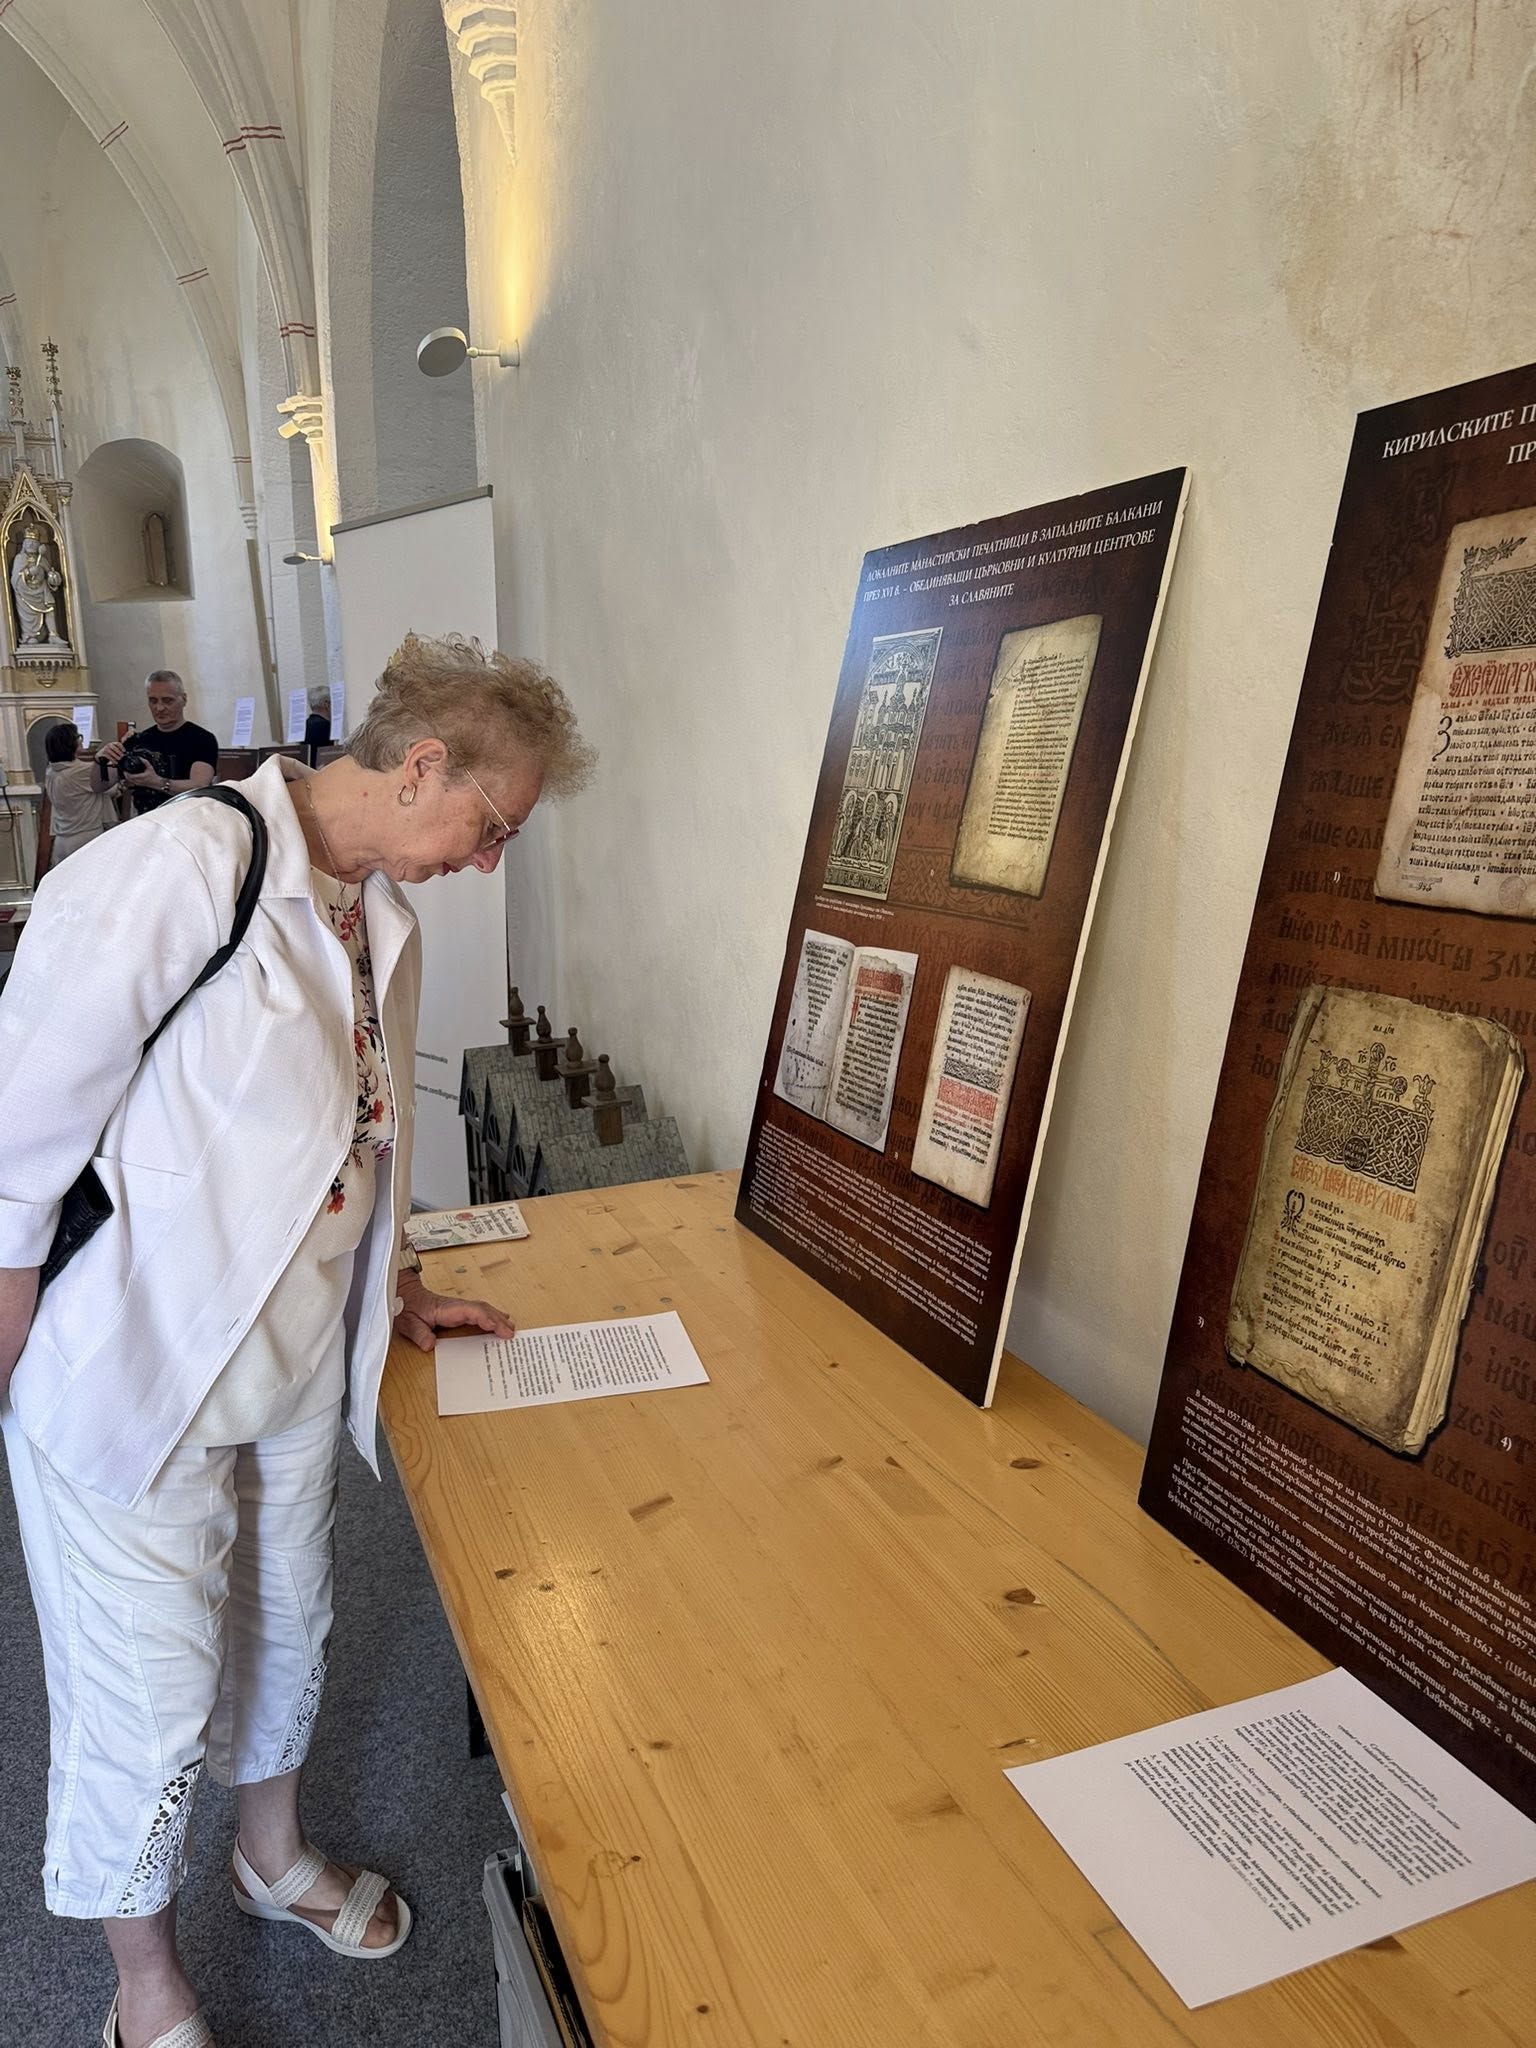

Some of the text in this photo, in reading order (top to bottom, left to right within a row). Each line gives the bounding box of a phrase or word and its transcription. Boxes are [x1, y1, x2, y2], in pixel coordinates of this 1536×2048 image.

[1381, 409, 1515, 459] КИРИЛСКИТЕ
[863, 589, 881, 602] ПРЕЗ
[909, 567, 972, 593] ОБЕДИНЯВАЩИ
[973, 555, 1025, 582] ЦЪРКОВНИ
[1026, 554, 1035, 567] И
[1037, 542, 1091, 566] КУЛТУРНИ
[1093, 528, 1155, 555] ЦЕНТРОВЕ
[866, 500, 1163, 582] ЛОКАЛНИТЕ МАНАСТИРСКИ ПЕЧАТНИЦИ В ЗАПАДНИТЕ БАЛКАНИ
[948, 582, 1015, 607] ЗА СЛАВЯНИТЕ
[1263, 1434, 1279, 1450] град
[1280, 1443, 1308, 1467] Брашов
[1315, 1467, 1344, 1491] център
[1344, 1486, 1355, 1497] на
[1356, 1491, 1404, 1528] кирилското
[1405, 1523, 1470, 1571] книгопечатане
[1471, 1566, 1490, 1584] във
[1500, 1437, 1512, 1451] 4)
[1248, 1530, 1257, 1540] са
[1280, 1554, 1286, 1562] с
[1261, 1514, 1275, 1529] XVI
[1281, 1528, 1296, 1544] във
[1295, 1538, 1323, 1563] Влашко
[1322, 1559, 1358, 1588] работят
[1357, 1584, 1363, 1593] и
[1362, 1588, 1407, 1625] печатници
[1407, 1618, 1414, 1629] в
[1413, 1625, 1460, 1662] градовете
[1460, 1655, 1511, 1699] Търговище
[1270, 1460, 1314, 1495] Българските
[1314, 1492, 1355, 1523] свещеници
[1355, 1519, 1365, 1529] са
[1365, 1525, 1413, 1562] превеждали
[1413, 1555, 1457, 1591] български
[1458, 1586, 1503, 1622] църковни
[1285, 1484, 1324, 1514] печатница
[1348, 1524, 1385, 1555] Първата
[1385, 1552, 1399, 1565] от
[1398, 1560, 1417, 1577] тях
[1417, 1573, 1423, 1582] е
[1424, 1575, 1453, 1602] Малък
[1453, 1598, 1489, 1626] октоих
[1489, 1622, 1505, 1637] от
[1506, 1631, 1528, 1650] 1557
[1289, 1462, 1322, 1488] Любавик
[1321, 1484, 1334, 1496] от
[1334, 1492, 1377, 1524] манастира
[1377, 1518, 1384, 1529] в
[1423, 1549, 1507, 1609] Функционирането
[1508, 1605, 1521, 1618] на
[1301, 1520, 1347, 1555] отпечатано
[1348, 1550, 1355, 1560] в
[1355, 1555, 1387, 1582] Брашов
[1387, 1580, 1401, 1593] от
[1401, 1590, 1417, 1605] дяк
[1418, 1599, 1450, 1627] Кореси
[1450, 1623, 1471, 1643] през
[1472, 1636, 1493, 1657] 1562
[1249, 1552, 1256, 1562] В
[1255, 1559, 1297, 1594] заставката
[1297, 1591, 1303, 1599] е
[1303, 1593, 1339, 1626] включено
[1339, 1623, 1366, 1646] името
[1366, 1643, 1377, 1655] на
[1377, 1650, 1422, 1690] йеромонах
[1294, 1576, 1339, 1613] отпечатано
[1340, 1611, 1353, 1624] от
[1354, 1620, 1397, 1657] йеромонах
[1398, 1653, 1447, 1695] Лаврентий
[1448, 1692, 1469, 1713] през
[1471, 1706, 1492, 1729] 1582
[1505, 1733, 1513, 1744] в
[1308, 1559, 1315, 1570] В
[1315, 1567, 1367, 1608] манастирите
[1388, 1618, 1425, 1653] Букурещ
[1426, 1649, 1451, 1669] също
[1452, 1667, 1495, 1703] работят
[1497, 1699, 1509, 1712] за
